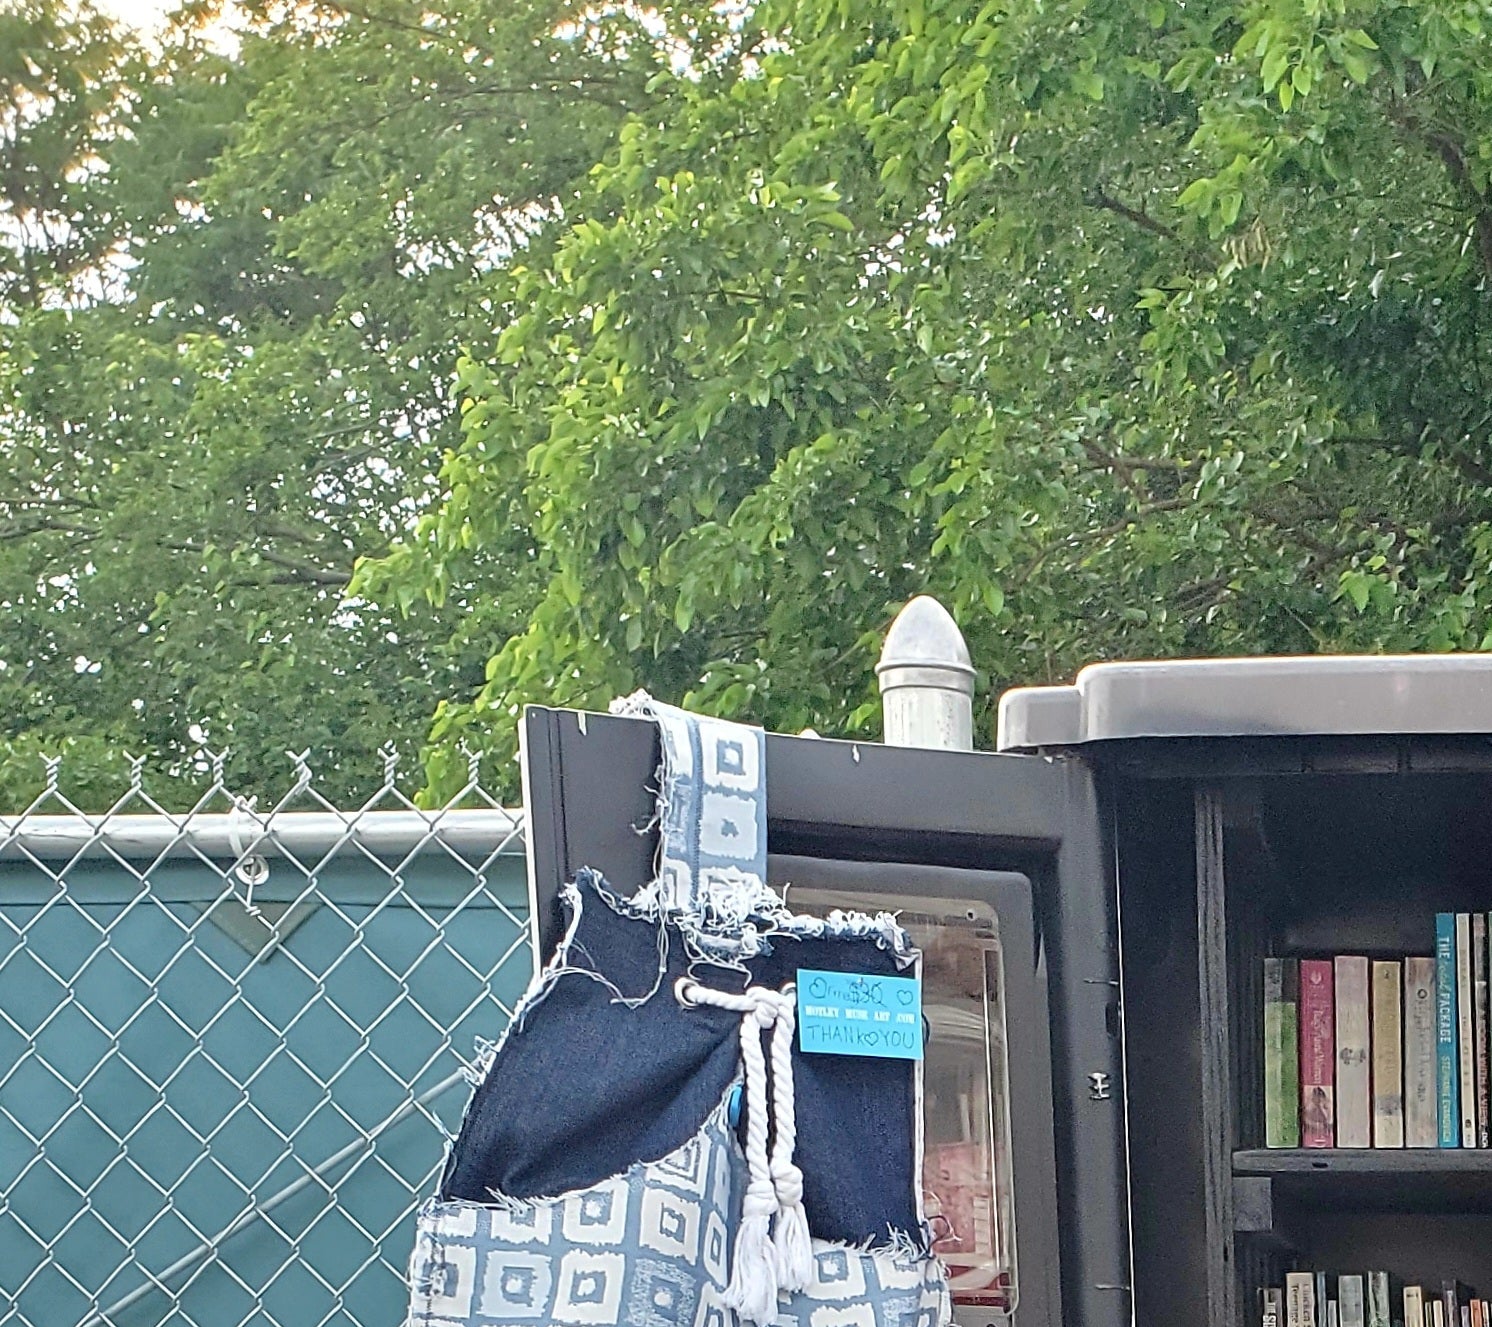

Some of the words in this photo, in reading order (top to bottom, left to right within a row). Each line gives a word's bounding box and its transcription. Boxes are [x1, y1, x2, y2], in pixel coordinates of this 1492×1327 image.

[1438, 936, 1449, 958] THE
[1439, 993, 1451, 1044] PACKAGE
[879, 1028, 915, 1049] YOU
